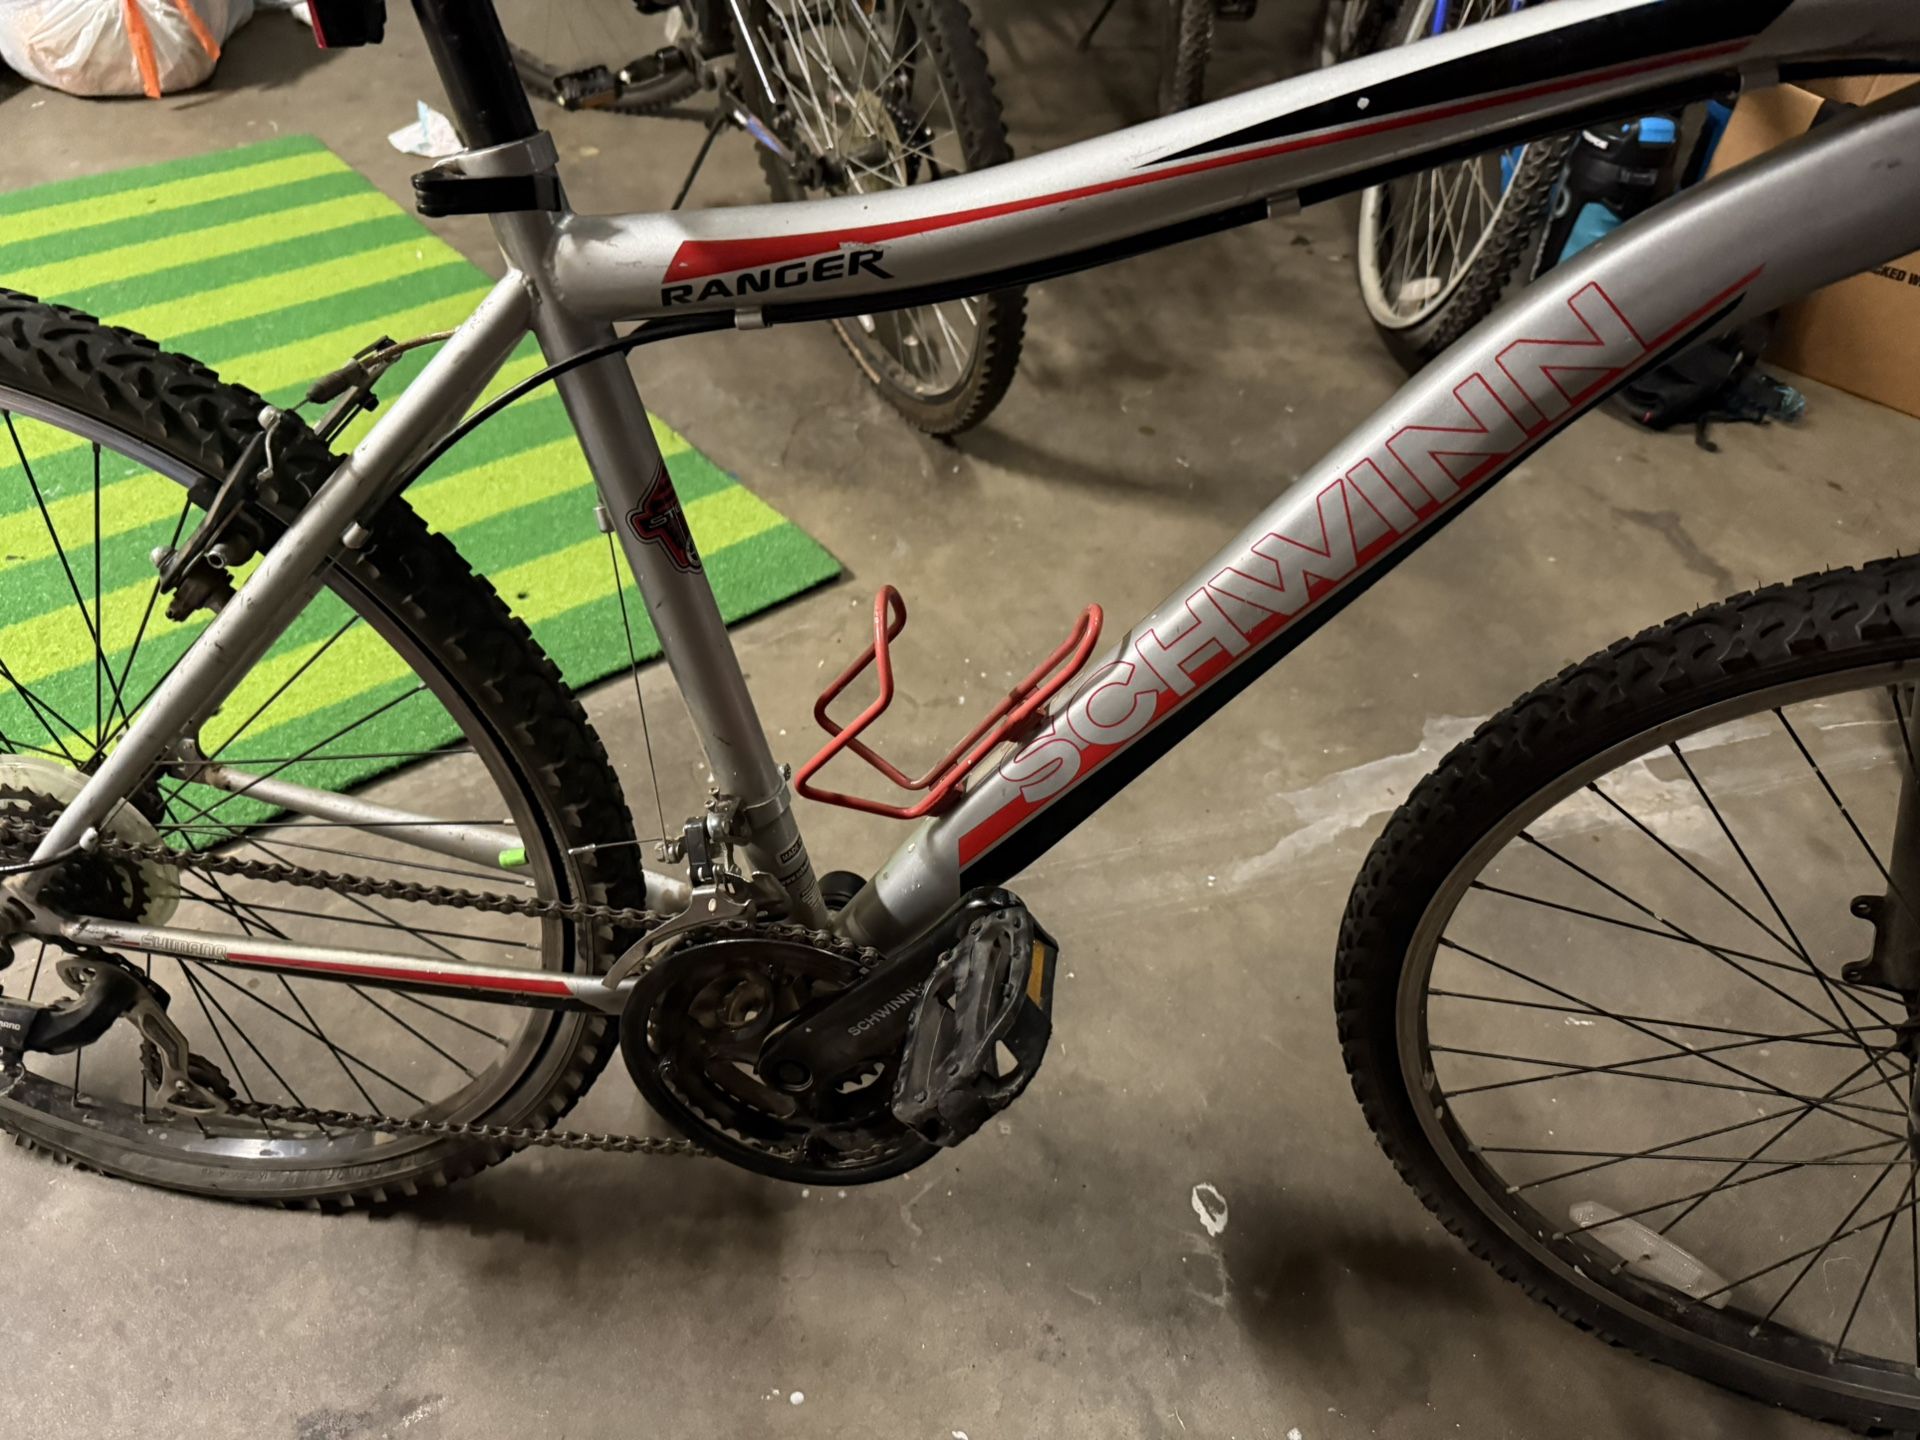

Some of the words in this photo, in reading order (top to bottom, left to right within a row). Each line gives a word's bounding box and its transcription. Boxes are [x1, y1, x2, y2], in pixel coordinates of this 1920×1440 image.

[661, 249, 895, 307] RANGER
[1001, 282, 1649, 803] SCHWINN
[141, 934, 227, 957] SHIMANO
[847, 988, 916, 1036] SCHWINN
